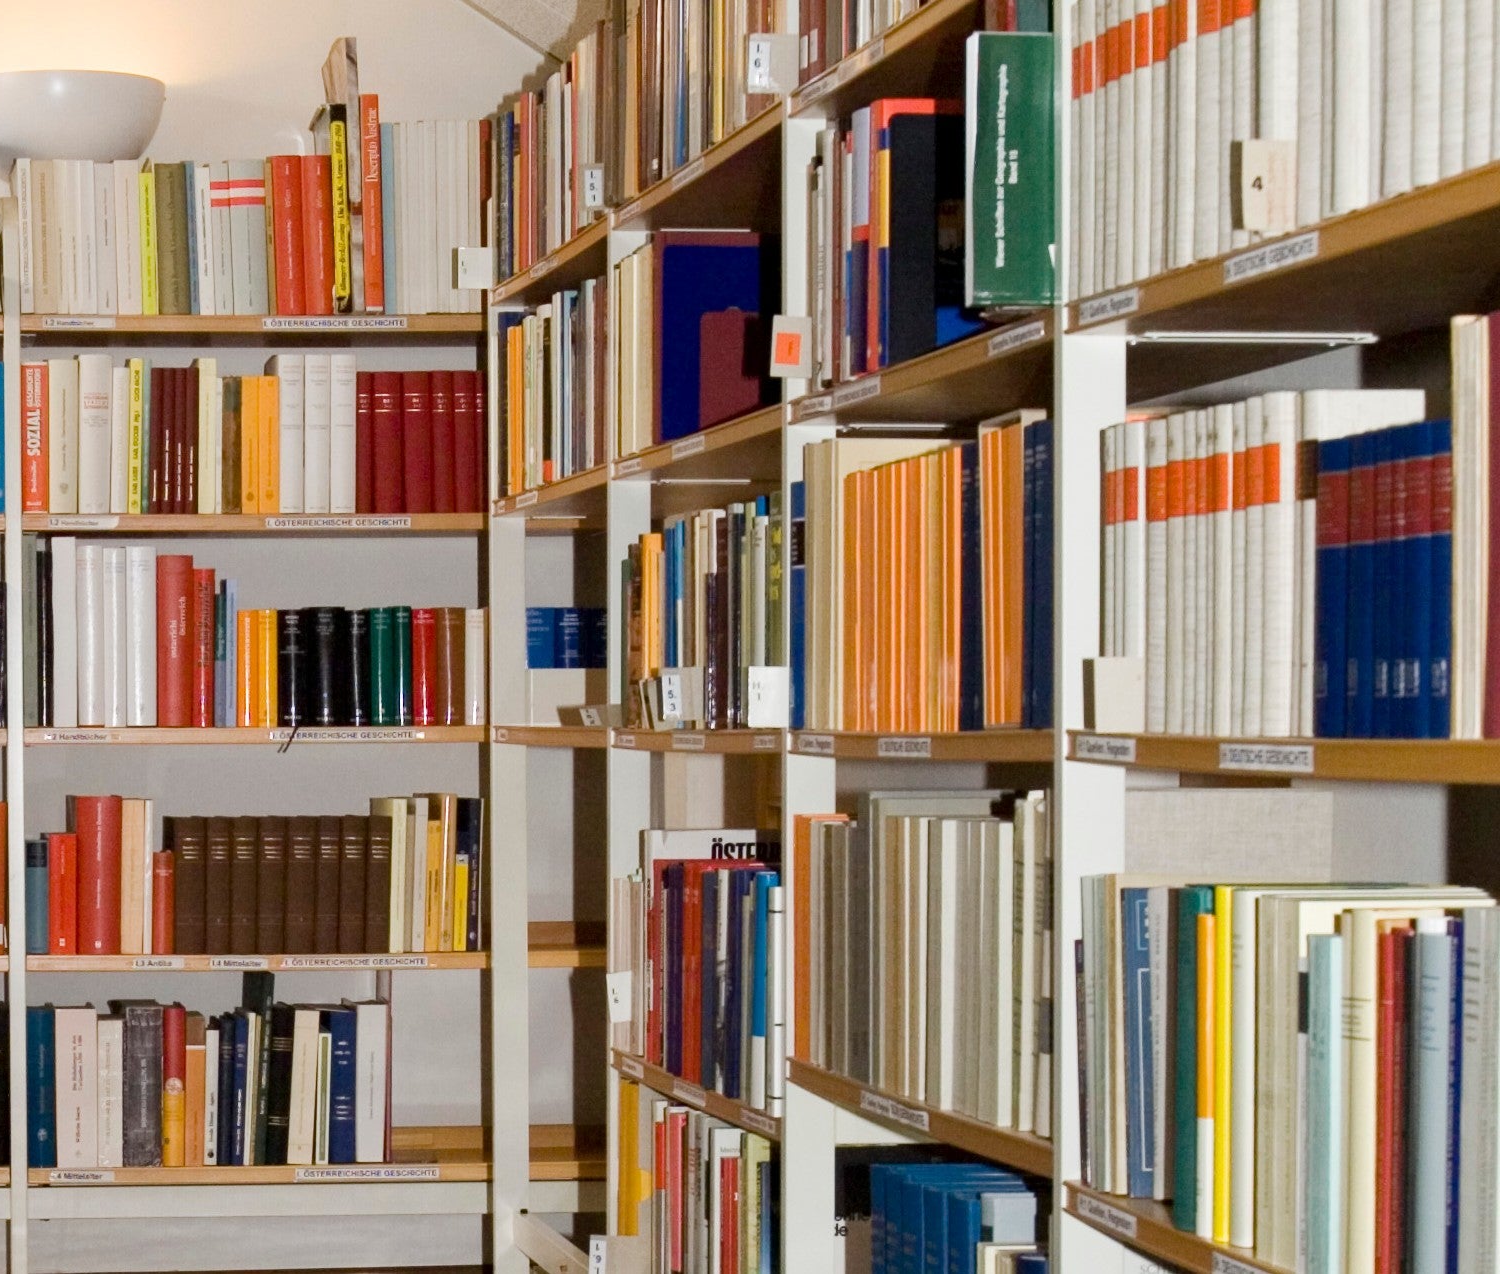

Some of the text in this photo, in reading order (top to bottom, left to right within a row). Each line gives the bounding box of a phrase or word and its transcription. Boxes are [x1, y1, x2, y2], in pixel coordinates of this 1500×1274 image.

[996, 119, 1006, 136] und
[365, 142, 379, 182] Descriptio
[995, 137, 1006, 185] Geographie
[1008, 162, 1018, 184] Band
[1252, 175, 1263, 192] 4
[591, 194, 596, 203] 1
[996, 186, 1004, 200] zur
[995, 200, 1005, 238] Schriften
[995, 239, 1005, 268] Wiener
[270, 318, 349, 327] ÖSTERREICHISCHE
[352, 319, 405, 327] GESCHICHTE
[27, 408, 41, 456] SOZIAL
[274, 518, 352, 527] ÖSTERREICHISCHE
[355, 518, 409, 526] GESCHICHTE
[178, 596, 186, 636] österreich
[169, 619, 177, 658] ostarrichi
[670, 703, 677, 712] 3
[59, 733, 107, 741] Handbücher
[360, 731, 413, 739] GESCHICHTE
[291, 957, 370, 966] ÖSTERREICHISCHE
[372, 957, 426, 966] GESCHICHTE
[303, 1169, 382, 1178] ÖSTERREICHISCHE
[384, 1169, 438, 1177] GESCHICHTE
